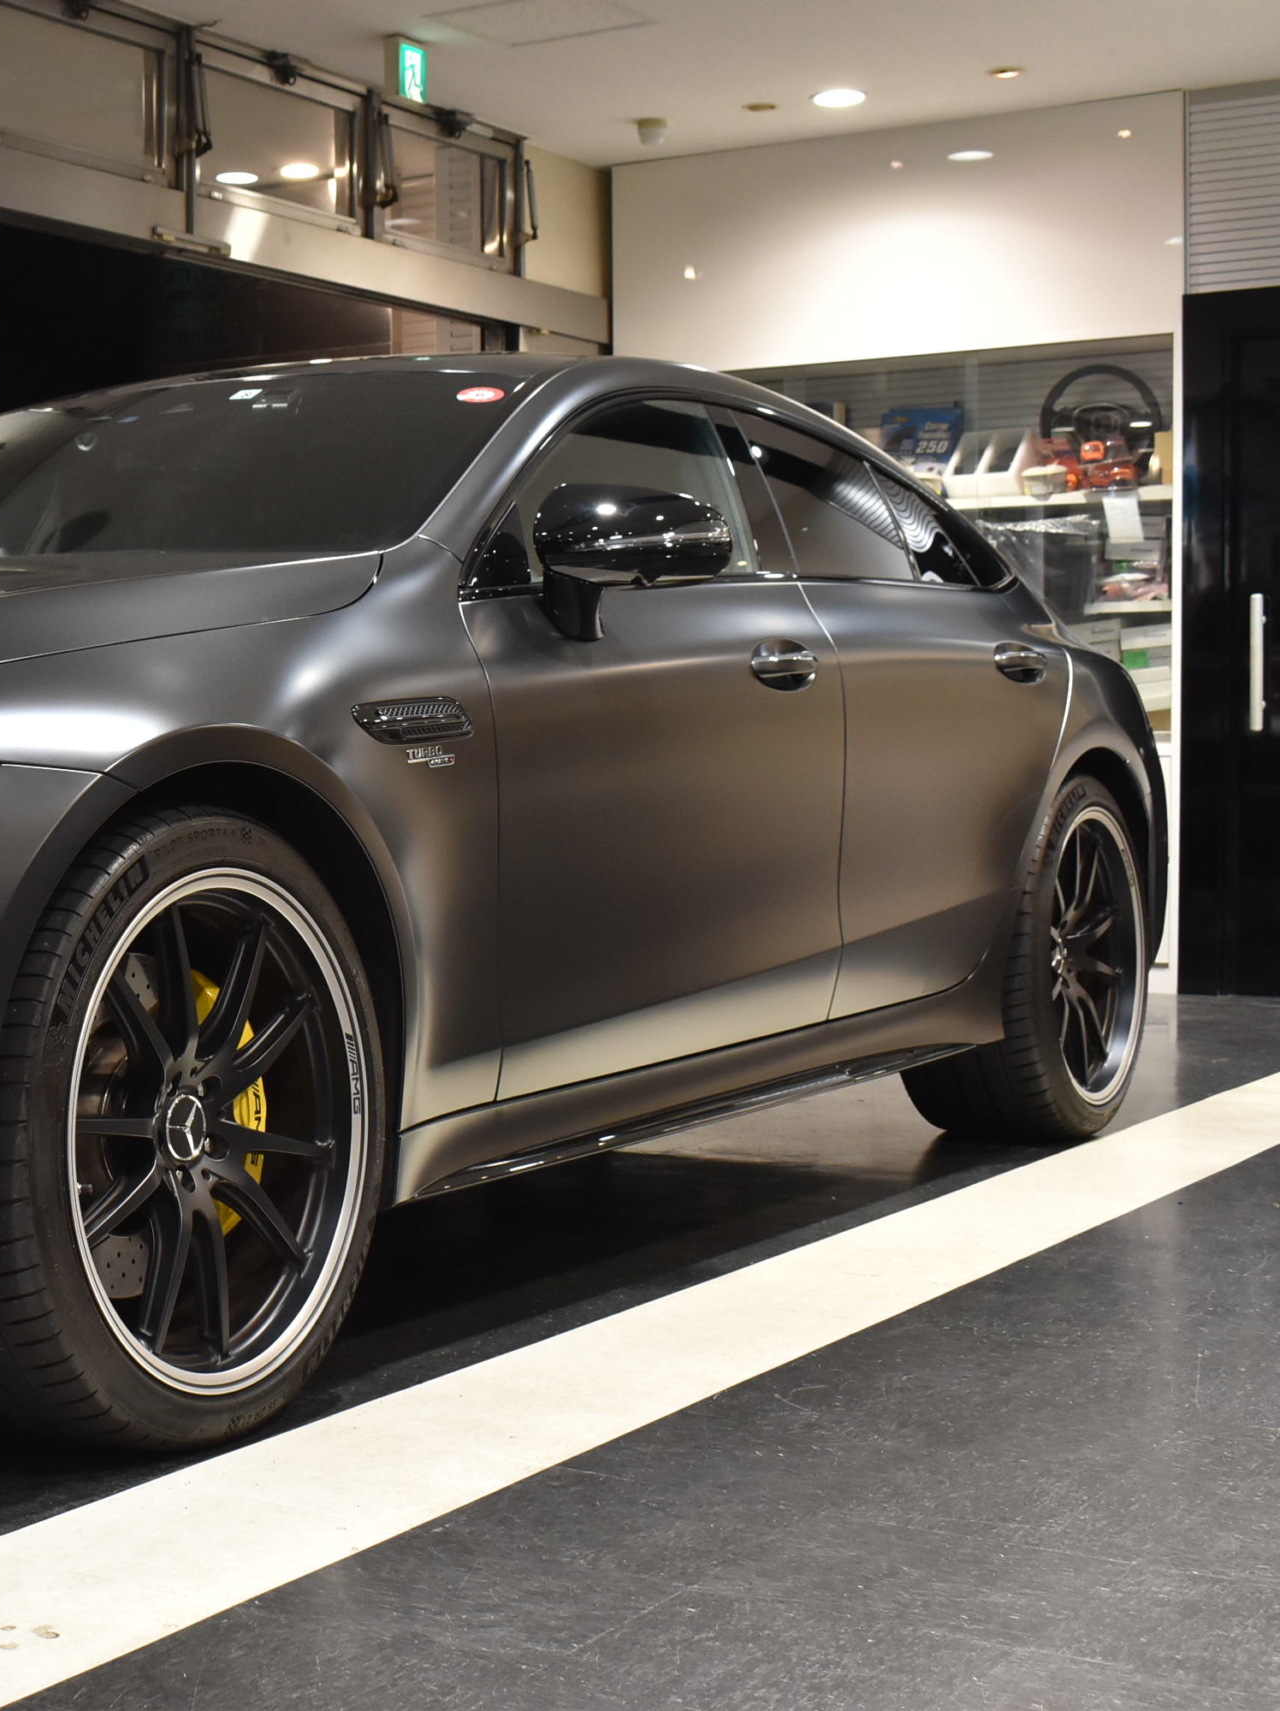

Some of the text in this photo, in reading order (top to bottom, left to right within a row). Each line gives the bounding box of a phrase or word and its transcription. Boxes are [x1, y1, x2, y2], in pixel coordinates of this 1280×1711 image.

[915, 440, 949, 454] 250
[406, 746, 443, 759] TURBO
[188, 828, 222, 842] SPORT
[56, 860, 147, 1017] MICHELIN
